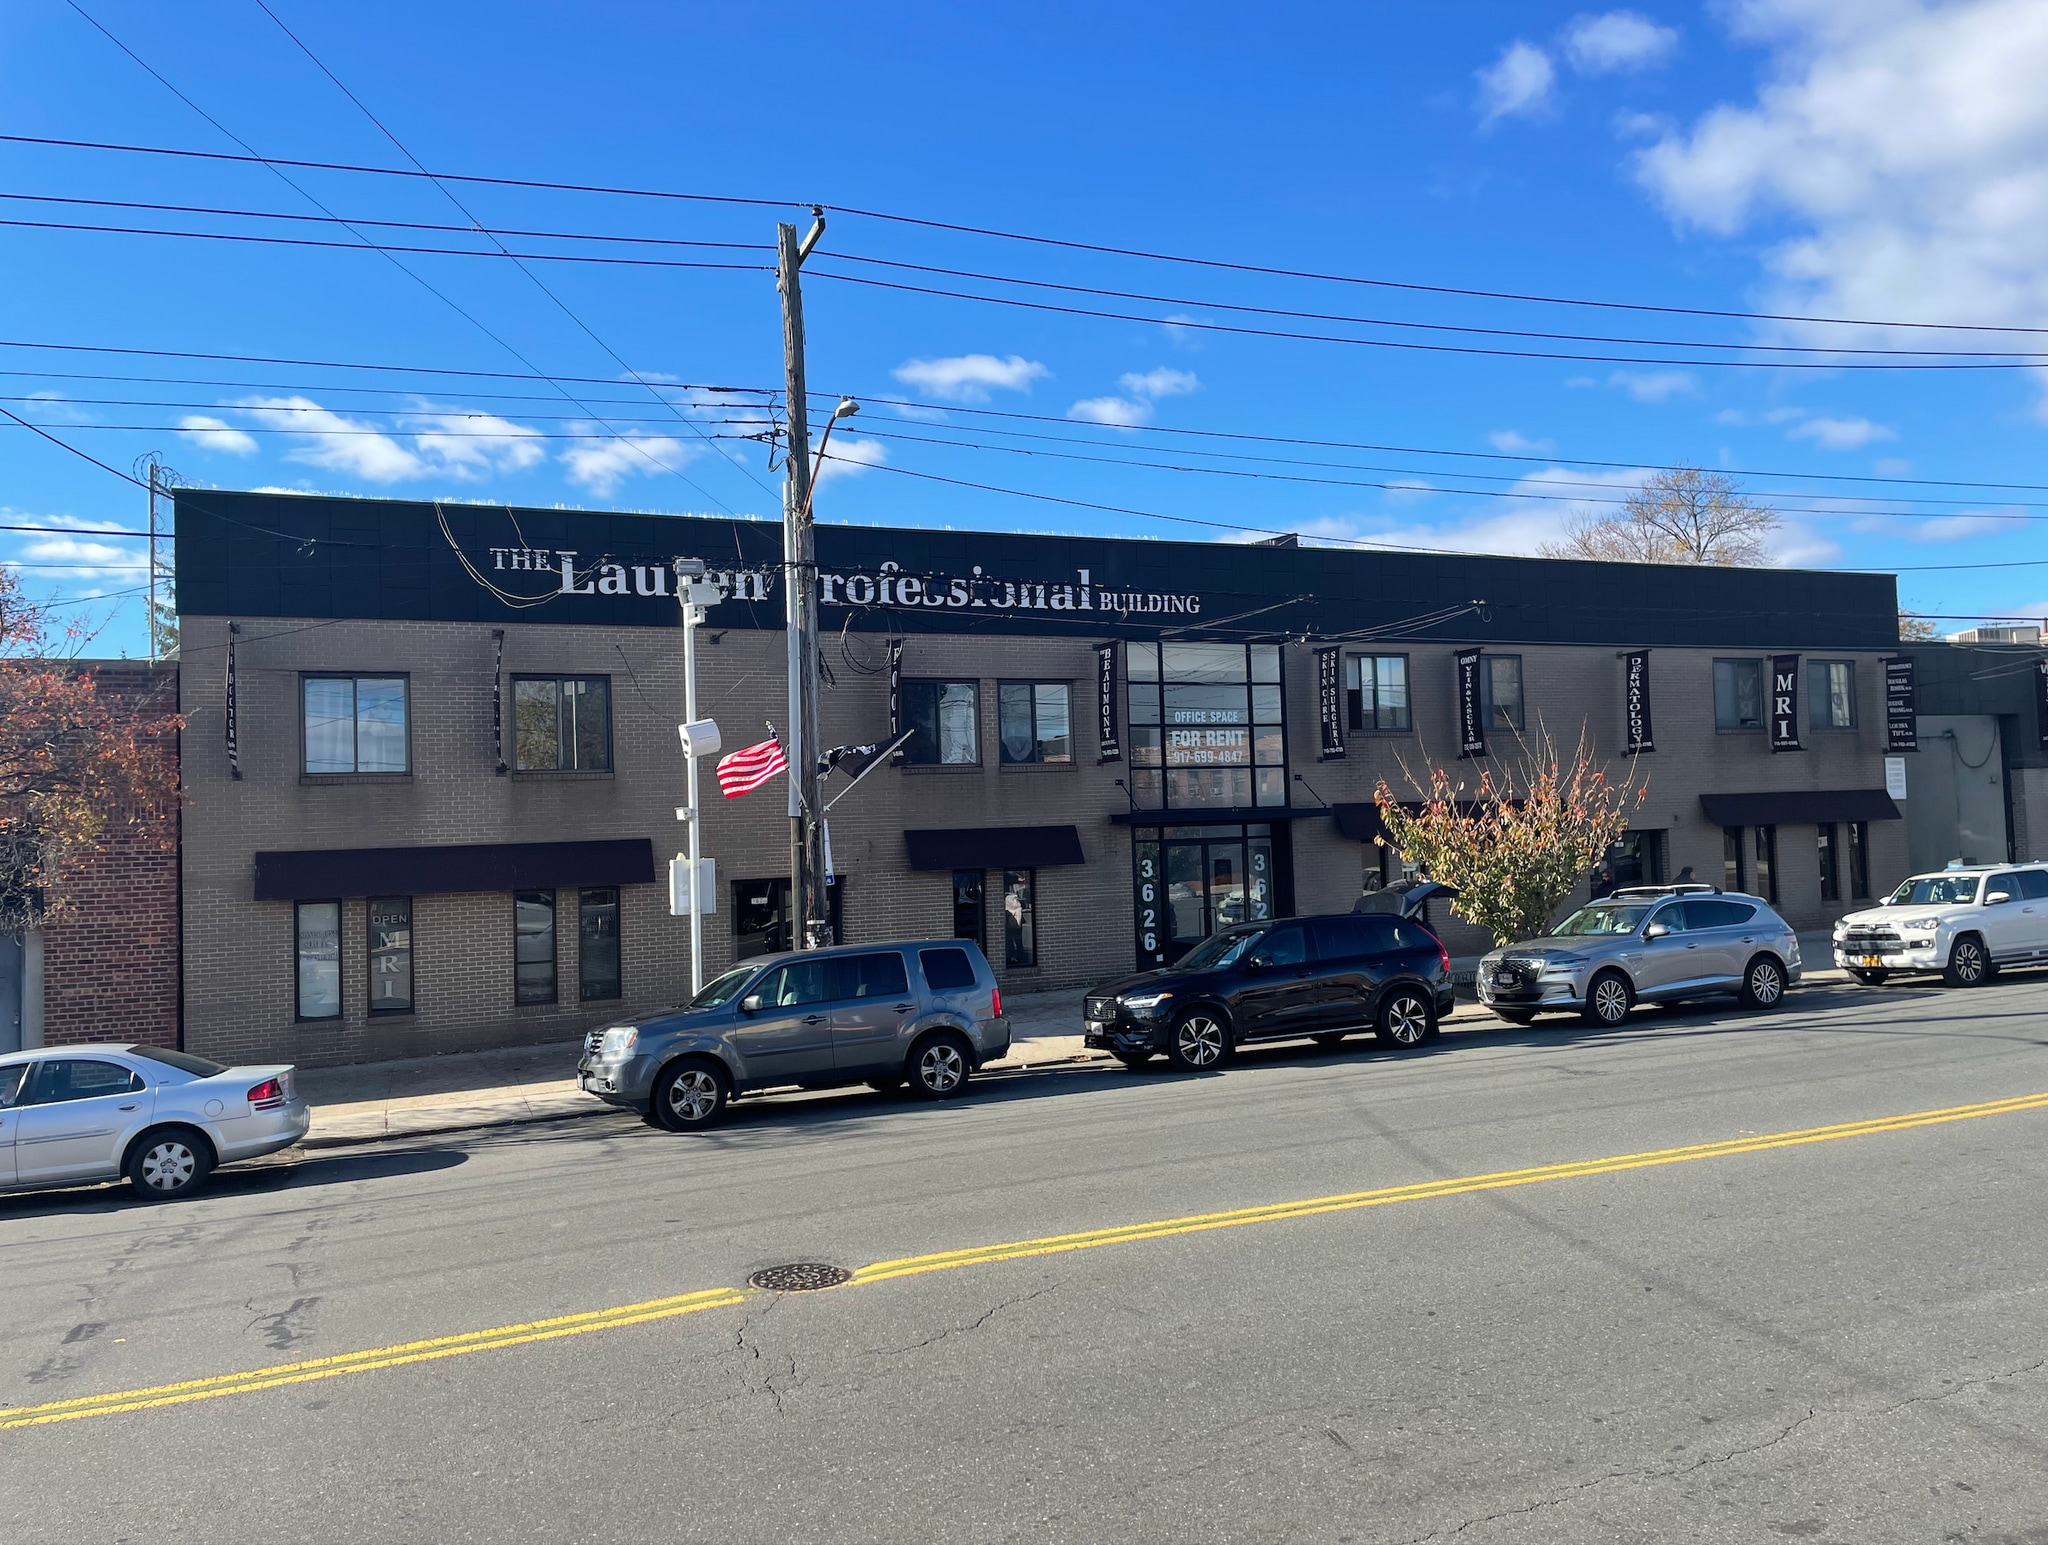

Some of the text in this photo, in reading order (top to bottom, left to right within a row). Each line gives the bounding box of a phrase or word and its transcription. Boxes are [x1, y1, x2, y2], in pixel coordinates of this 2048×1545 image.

[489, 547, 1201, 614] THE Lauen rofessional BUILDING
[1102, 648, 1112, 738] BEAUMONT
[1174, 711, 1238, 723] OFFICE SPACE
[1330, 687, 1340, 746] SURGERY
[1629, 657, 1643, 743] DERMATOLOGY
[1775, 673, 1794, 738] MRI
[1171, 730, 1244, 747] FOR RENT
[1174, 750, 1243, 764] 917-699-4847
[372, 914, 408, 925] OPEN
[1141, 859, 1157, 951] 3626
[379, 931, 401, 998] MRI
